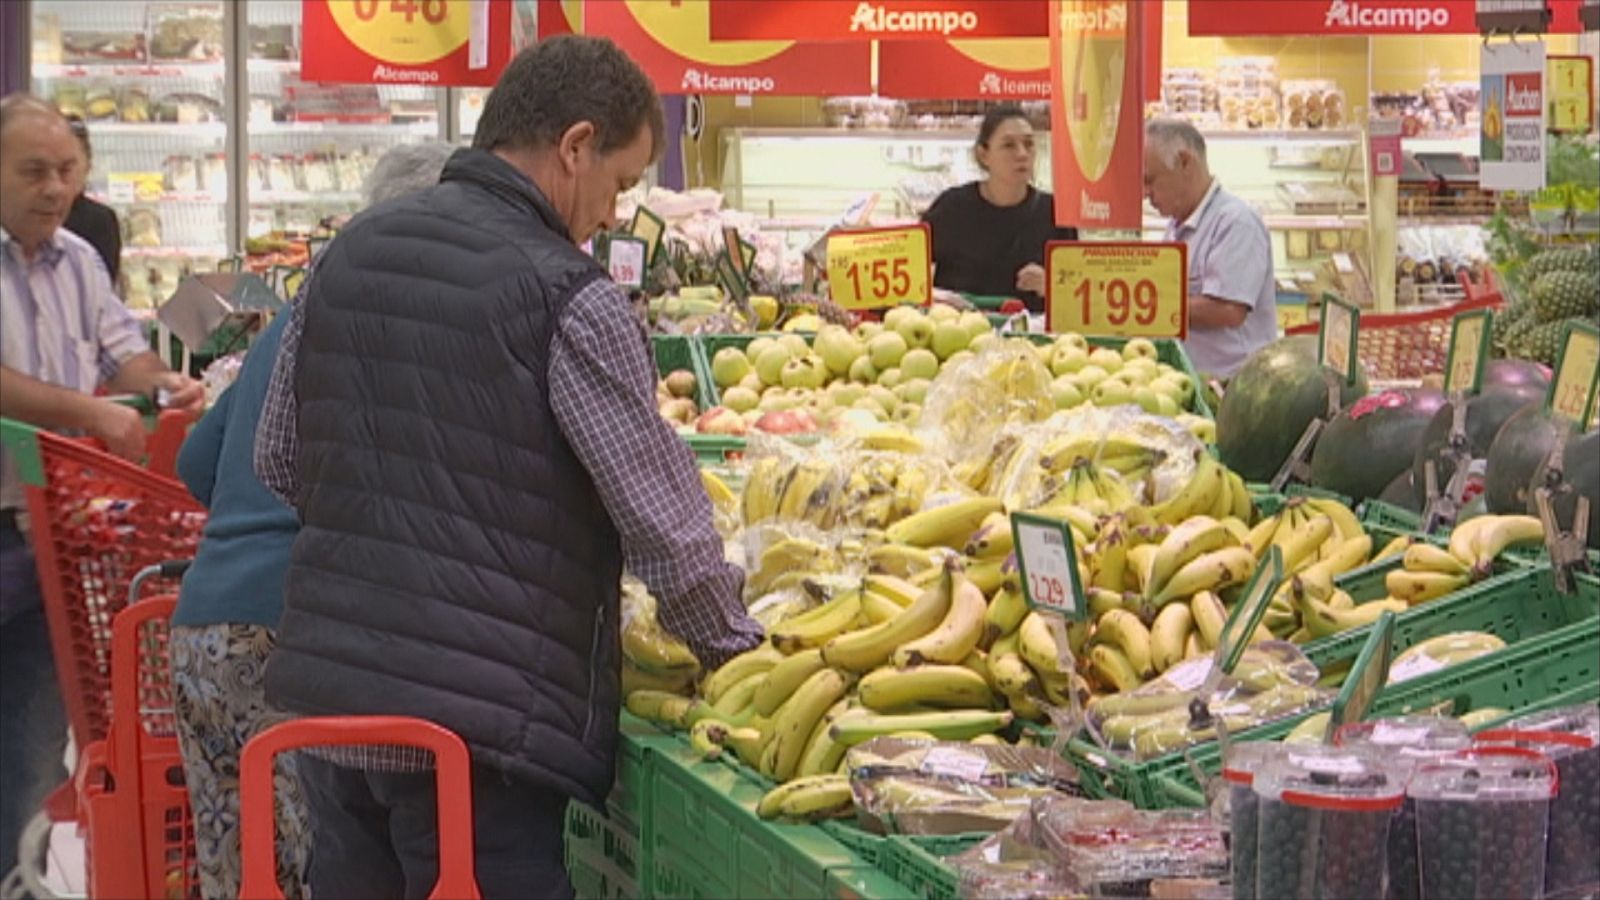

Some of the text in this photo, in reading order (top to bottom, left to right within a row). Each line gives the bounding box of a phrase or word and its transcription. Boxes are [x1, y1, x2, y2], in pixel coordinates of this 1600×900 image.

[850, 2, 977, 34] Alcampo
[1325, 0, 1449, 31] Alcampo
[372, 64, 439, 83] Alcampo
[681, 68, 774, 93] Alcampo
[979, 72, 1051, 97] Alcamp
[846, 256, 912, 302] 1'55
[1073, 277, 1159, 326] 1'99
